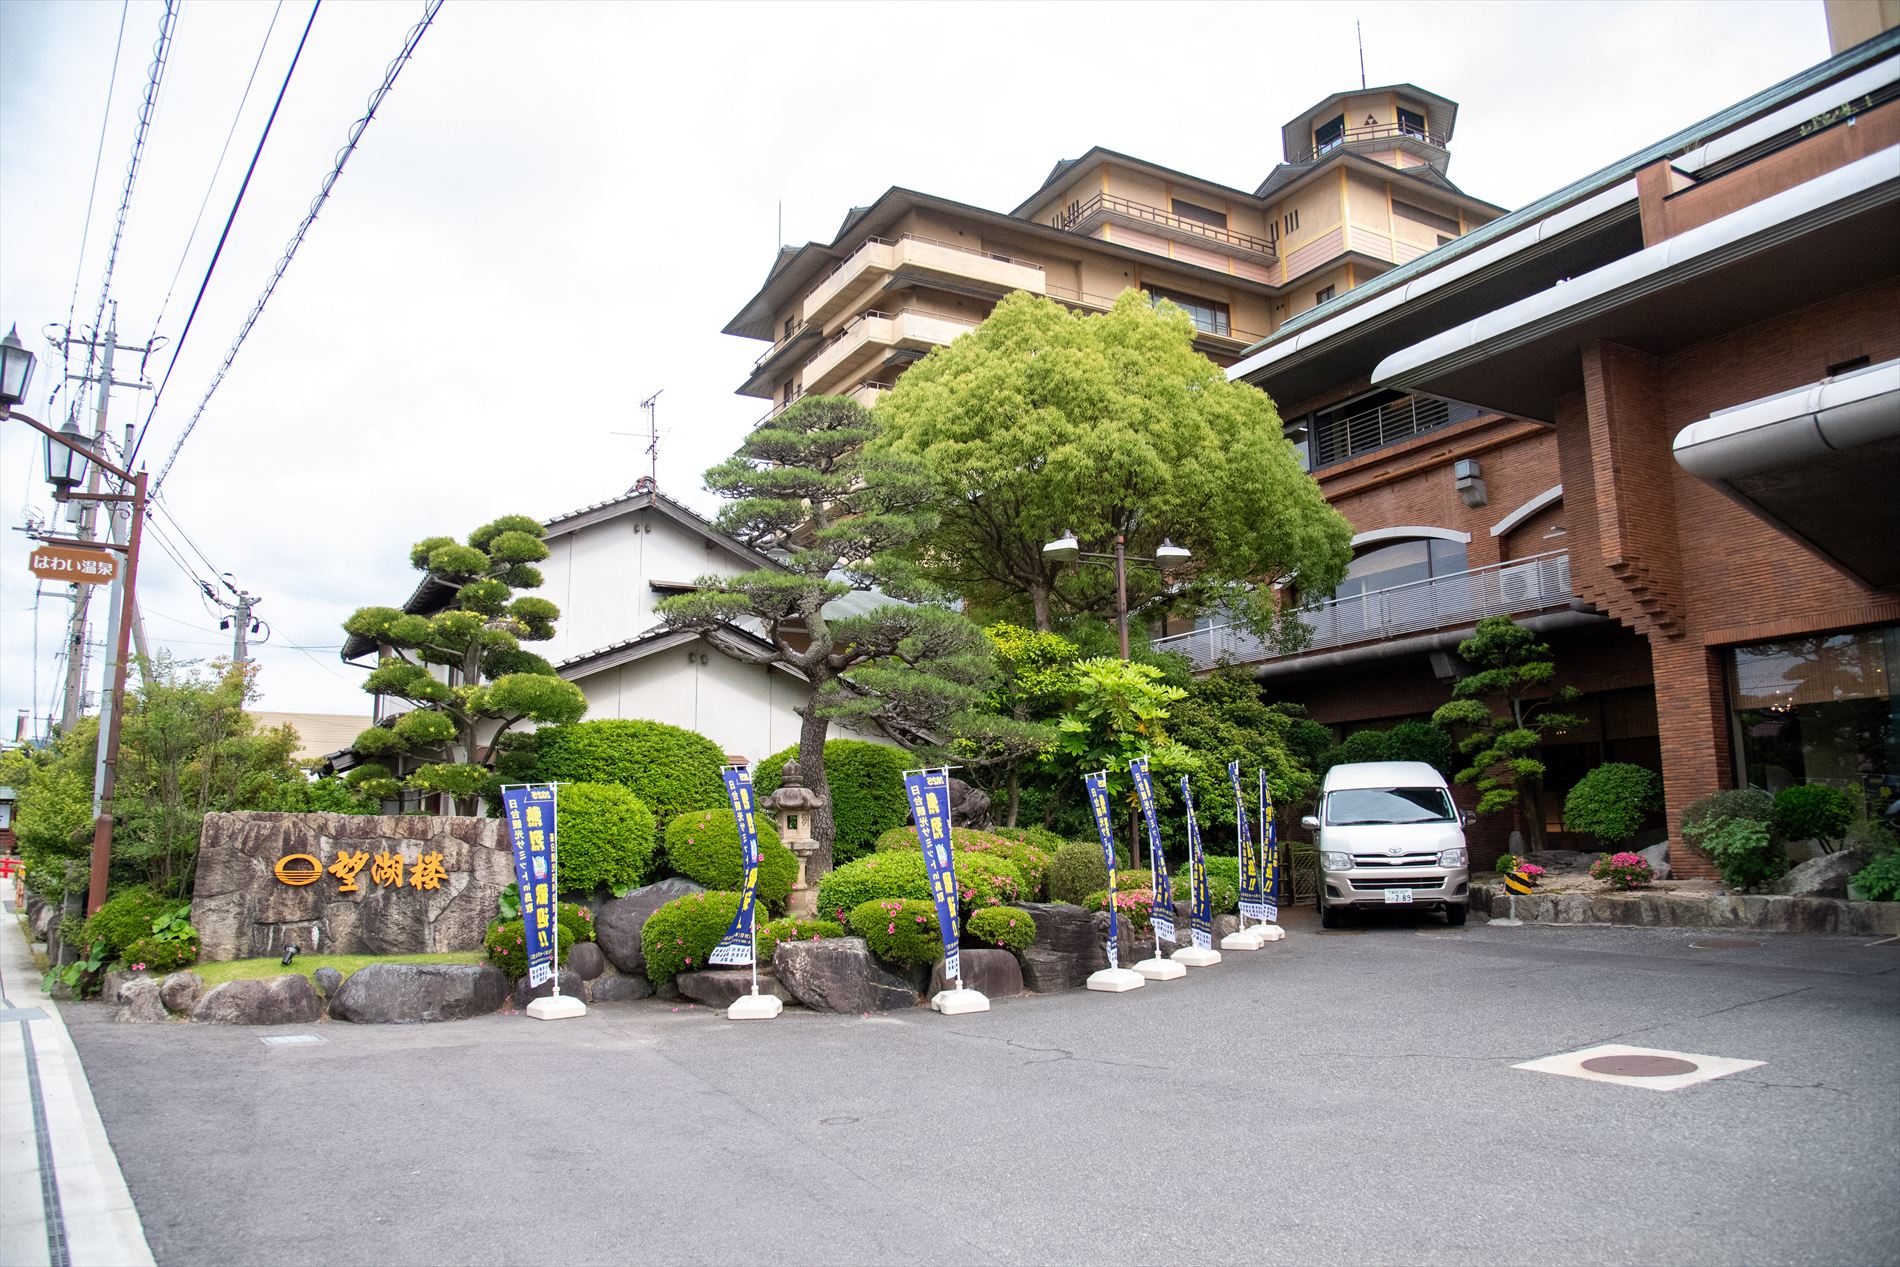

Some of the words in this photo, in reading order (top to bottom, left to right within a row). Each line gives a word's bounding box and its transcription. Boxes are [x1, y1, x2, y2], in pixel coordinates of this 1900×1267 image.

[33, 555, 113, 576] はわい温泉
[327, 850, 449, 892] 望湖楼
